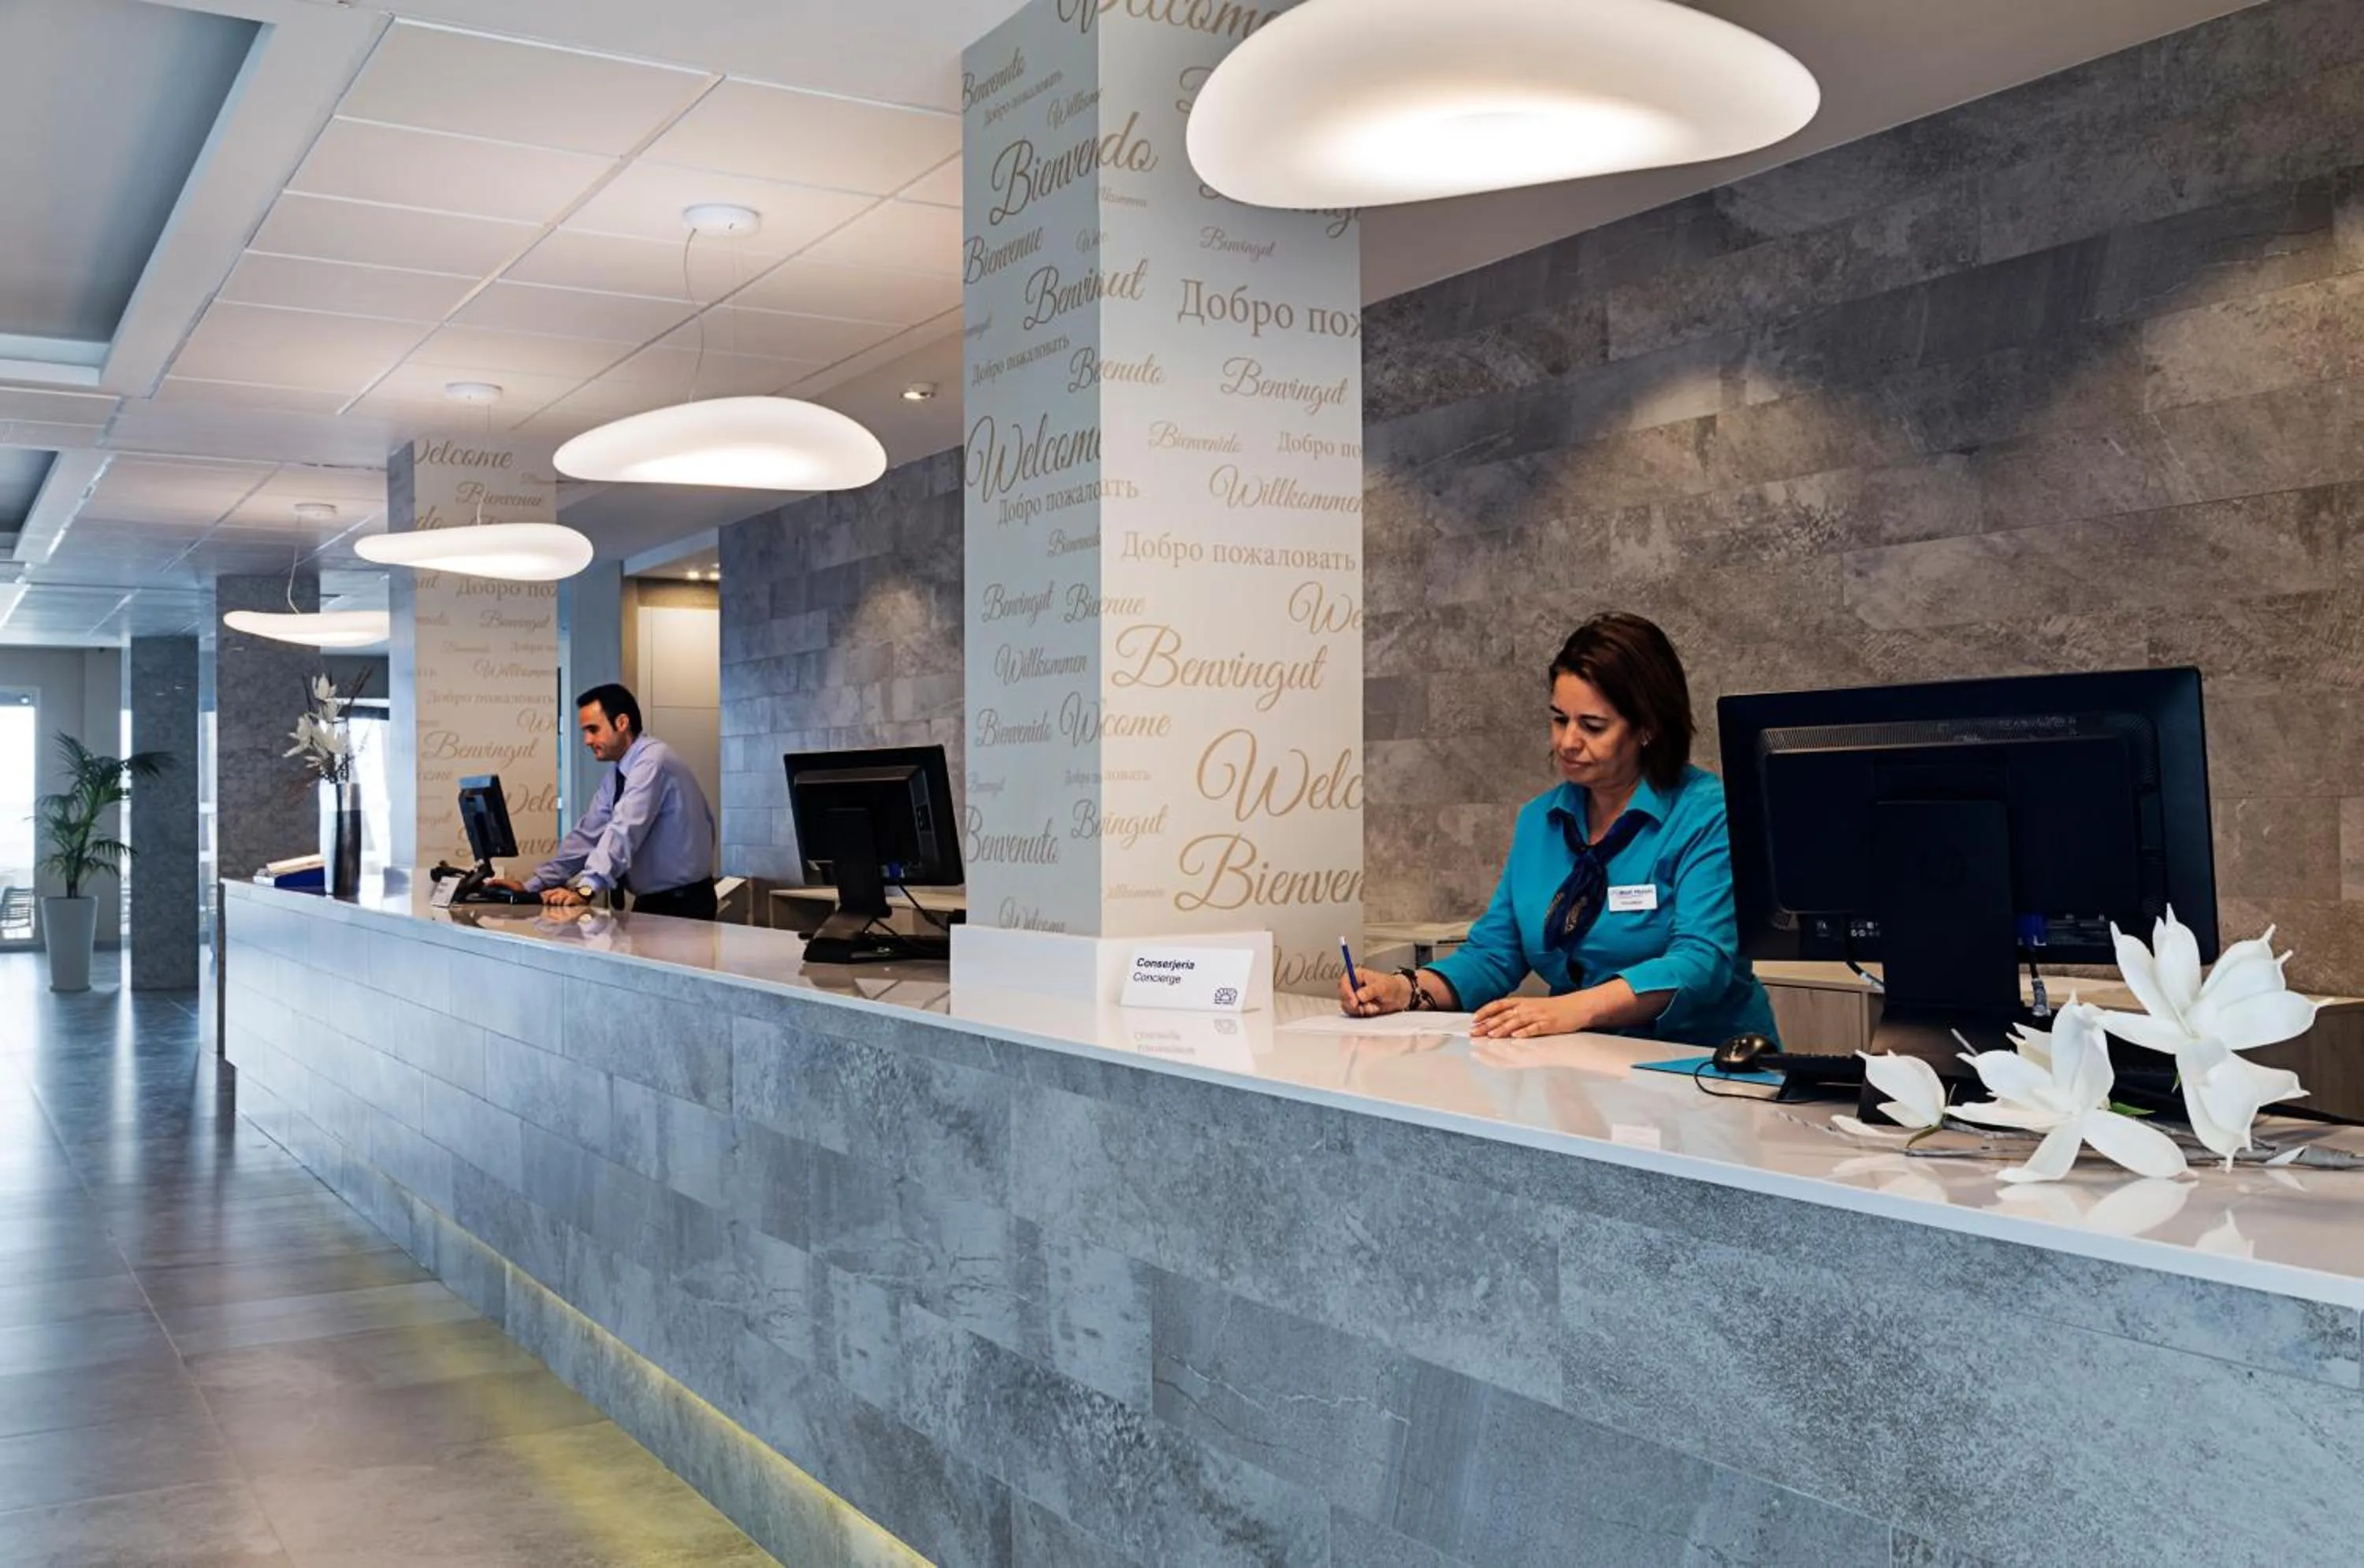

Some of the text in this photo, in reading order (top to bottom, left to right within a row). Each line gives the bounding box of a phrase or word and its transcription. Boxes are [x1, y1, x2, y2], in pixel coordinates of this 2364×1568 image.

[1177, 280, 1294, 331] Добро
[1220, 357, 1349, 416] Benvingut
[1277, 431, 1335, 460] Добро
[998, 492, 1042, 527] Добро
[1121, 530, 1356, 572] Добро пожаловать
[1110, 623, 1330, 713] Benvingut
[422, 730, 537, 770] Benvingut
[965, 804, 1060, 864] Benvenuto
[1133, 972, 1181, 986] Concierge
